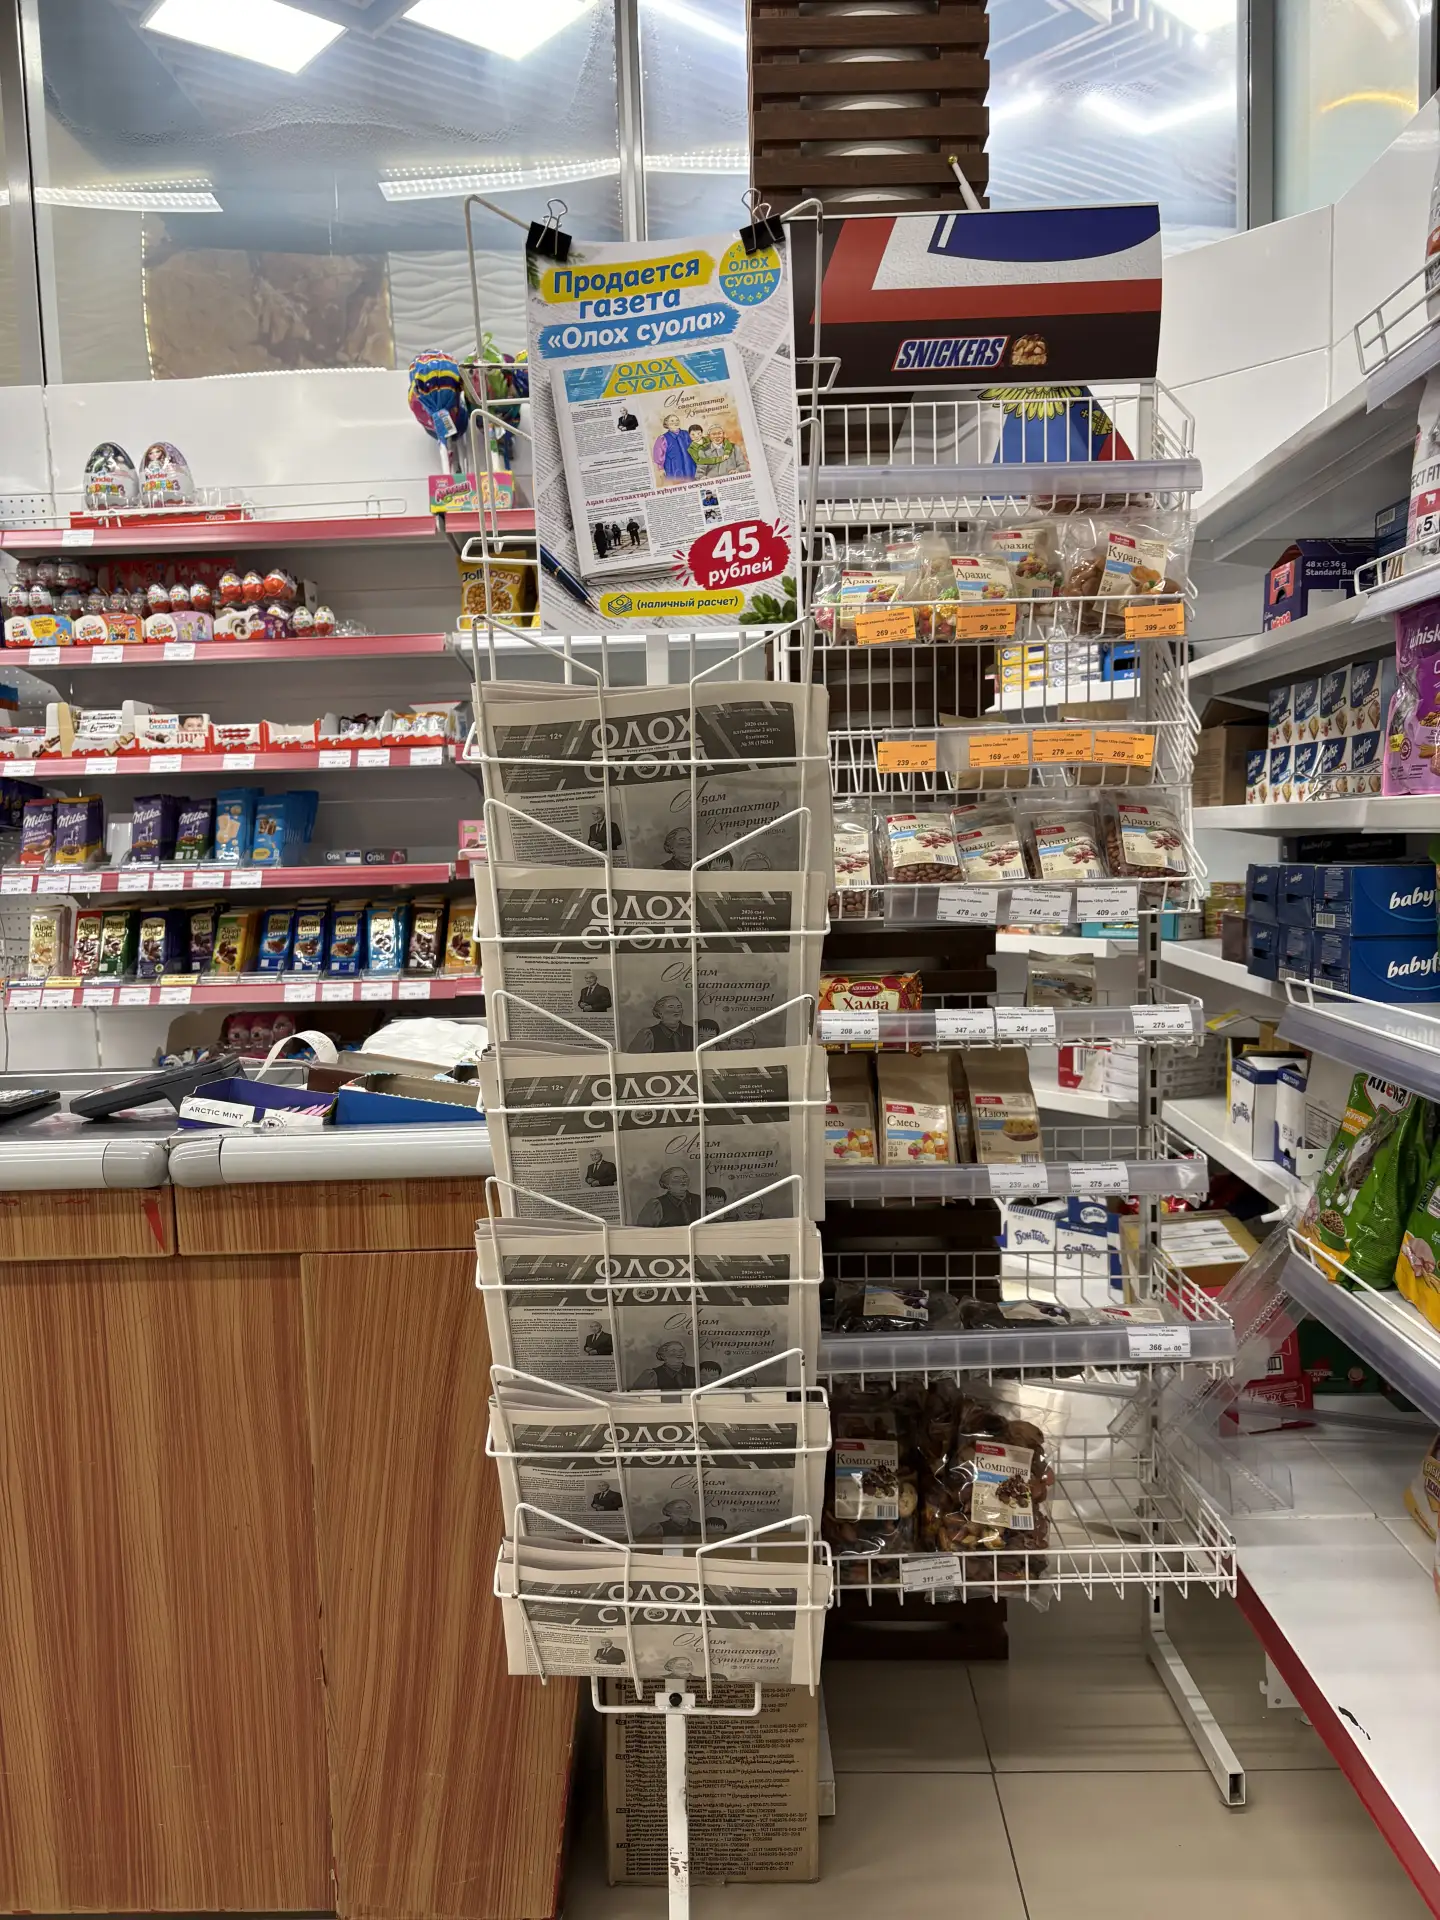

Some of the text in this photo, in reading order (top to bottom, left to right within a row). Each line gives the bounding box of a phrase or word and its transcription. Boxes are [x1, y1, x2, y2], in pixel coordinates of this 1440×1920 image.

[728, 256, 769, 271] ОЛОХ
[554, 259, 699, 298] Продается
[724, 271, 775, 289] СУОЛА
[580, 289, 680, 319] газета
[548, 311, 725, 350] «Олох суола»
[898, 338, 1005, 369] SNICKERS
[617, 358, 677, 378] ОЛОХ
[614, 373, 687, 395] СУОЛА
[1424, 515, 1433, 531] 5
[712, 525, 759, 562] 45
[1108, 544, 1143, 566] Курага
[708, 556, 773, 586] рублей
[955, 569, 991, 580] Арахис
[637, 595, 739, 611] (наличный расчет)
[876, 629, 888, 637] 269
[549, 732, 564, 741] 12+
[591, 714, 701, 749] ОЛОХ
[583, 756, 716, 784] СУОЛА
[23, 812, 52, 827] Milka
[57, 812, 87, 827] Milka
[132, 809, 161, 824] Milka
[179, 811, 210, 825] Milka
[1121, 815, 1160, 826] Арахис
[890, 824, 929, 833] Арахис
[958, 841, 995, 853] Арахис
[1038, 835, 1079, 848] Арахис
[366, 853, 385, 862] Orbit
[550, 897, 563, 905] 12+
[1389, 887, 1436, 909] baby
[590, 895, 700, 920] ОЛОХ
[33, 924, 55, 932] Alpen
[35, 930, 53, 938] Gold
[80, 922, 98, 930] Alpen
[580, 924, 709, 951] СУОЛА
[843, 996, 889, 1010] Халва
[591, 1074, 698, 1100] ОЛОХ
[189, 1106, 244, 1120] ARCTIC MINT
[583, 1103, 709, 1129] СУОЛА
[978, 1108, 1009, 1118] Изюм
[887, 1115, 920, 1128] Смесь
[595, 1259, 700, 1278] ОЛОХ
[586, 1280, 709, 1302] СУОЛА
[603, 1425, 708, 1443] ОЛОХ
[836, 1454, 896, 1467] Компотная
[976, 1456, 1029, 1477] Компотная
[607, 1584, 709, 1602] ОЛОХ
[598, 1605, 718, 1625] СУОЛА
